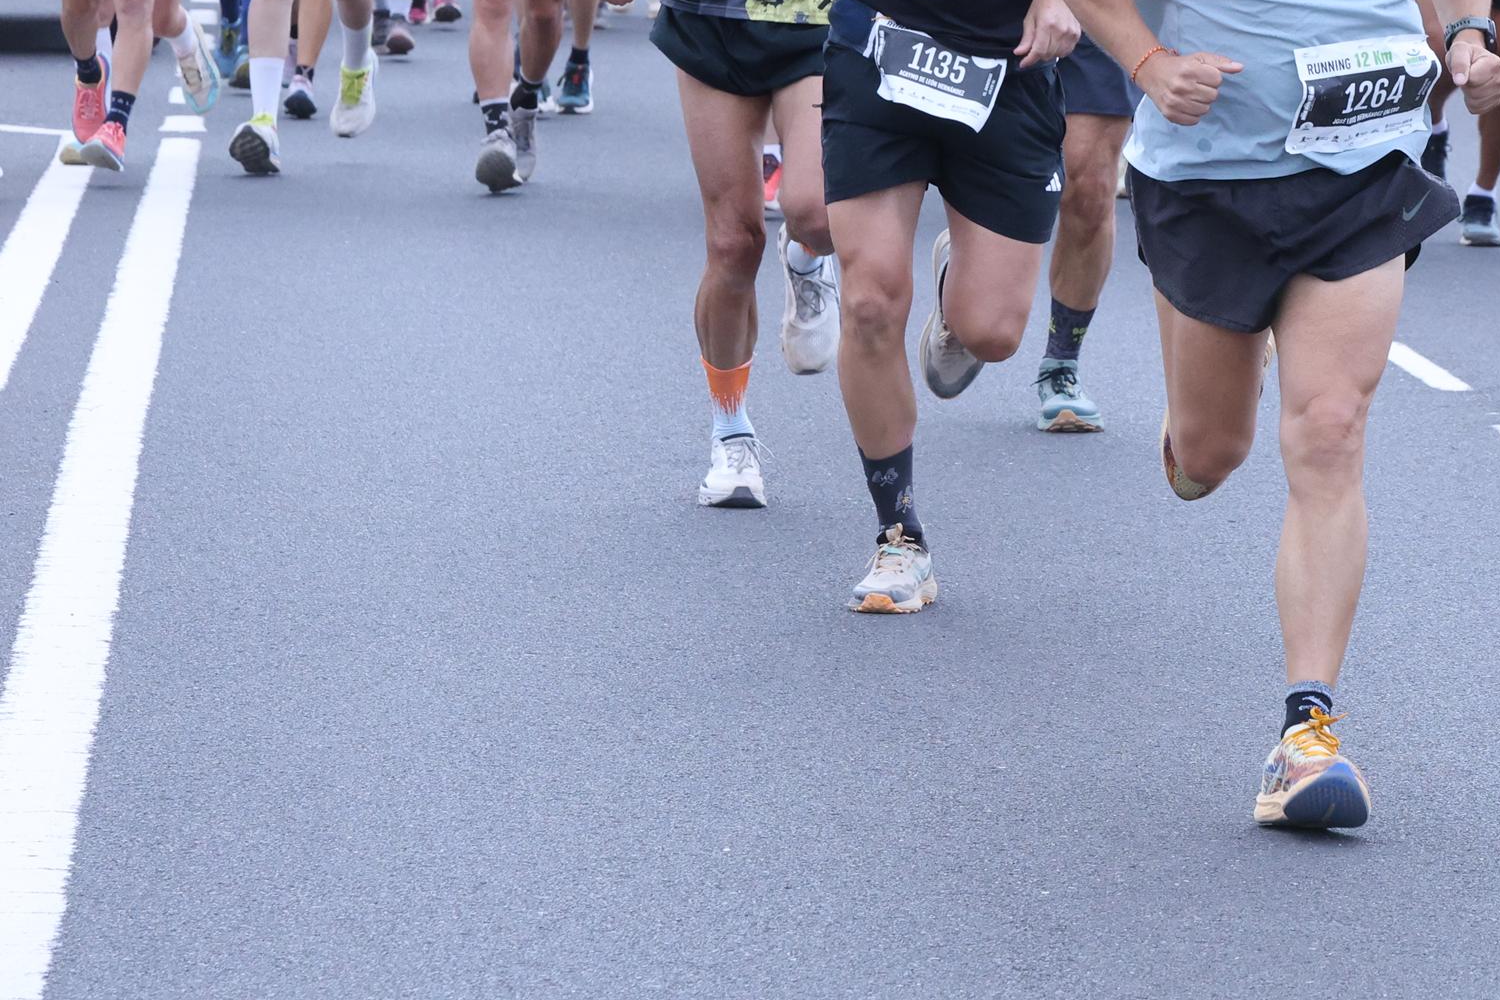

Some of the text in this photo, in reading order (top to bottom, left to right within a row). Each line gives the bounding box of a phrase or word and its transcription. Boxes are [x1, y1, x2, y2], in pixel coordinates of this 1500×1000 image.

[907, 42, 970, 84] 1135
[1307, 50, 1393, 75] RUNNING 12 Km
[1342, 75, 1406, 115] 1264
